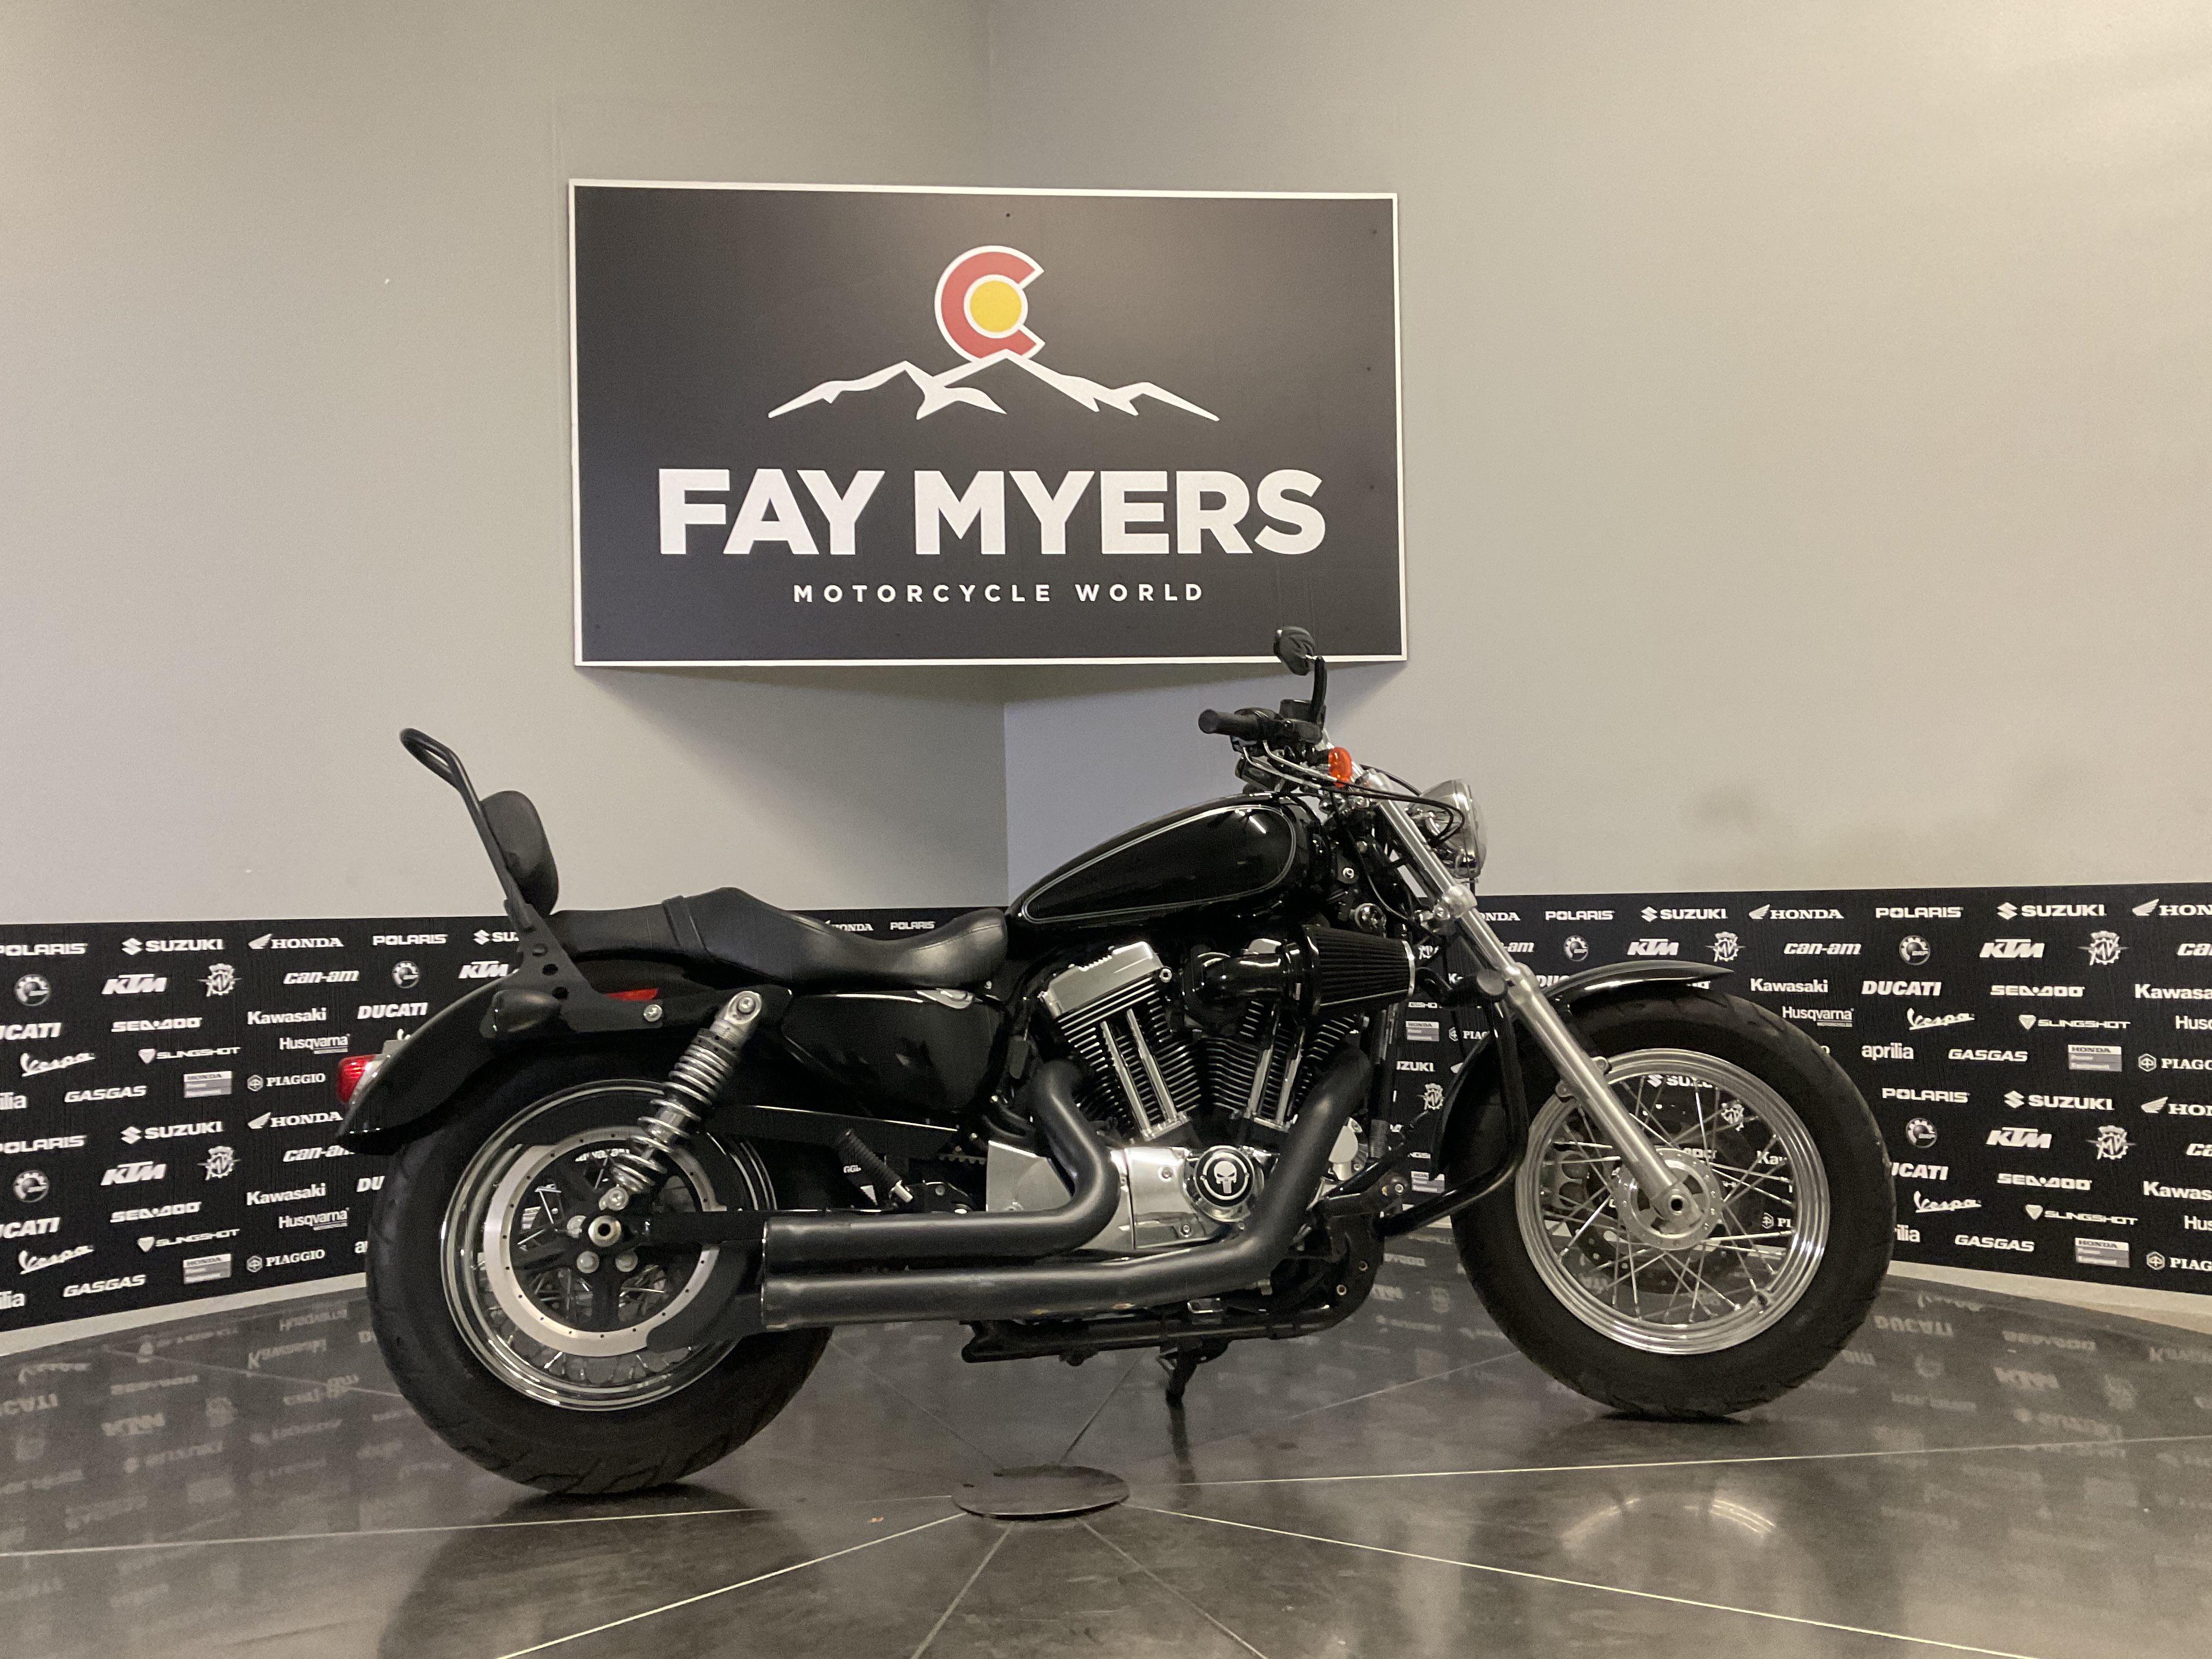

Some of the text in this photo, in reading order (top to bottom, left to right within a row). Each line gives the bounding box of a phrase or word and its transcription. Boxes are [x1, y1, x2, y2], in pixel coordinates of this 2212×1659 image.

[659, 469, 1325, 555] FAY MYERS
[794, 583, 1202, 603] MOTORCYCLE WORLD
[1545, 910, 1613, 920] POLARIS
[1660, 909, 1728, 919] SUZUKI
[1770, 910, 1844, 919] HONDA
[1876, 907, 1963, 918] POLARIS
[2022, 905, 2107, 917] SUZUKI
[2159, 905, 2212, 916] HON
[890, 921, 935, 930] POLARIS
[145, 939, 224, 952] SUZUKI
[271, 938, 343, 949] HONDA
[373, 934, 447, 945] POLARIS
[1627, 939, 1679, 955] KTM
[1784, 944, 1861, 955] can-am
[1979, 939, 2045, 958] KTM
[284, 970, 359, 984] can-am
[459, 961, 509, 979] KTM
[102, 974, 167, 994] KTM
[1751, 978, 1828, 992] Kawasaki
[1861, 981, 1942, 996] DUCATI
[2135, 984, 2212, 999] Kawasa
[247, 1008, 326, 1024] Kawasaki
[358, 1002, 428, 1019] DUCATI
[1782, 1006, 1852, 1021] Husqvarna
[1907, 1008, 1974, 1030] Vespa
[2038, 1019, 2131, 1029] SLINGSHOT
[280, 1036, 348, 1049] Husqvarna
[156, 1047, 240, 1059] SLINGSHOT
[1862, 1042, 1914, 1060] aprilia
[1949, 1049, 2028, 1062] GASGAS
[20, 1053, 95, 1076] Vespa
[267, 1073, 325, 1086] PIAGGIO
[65, 1086, 146, 1102] GASGAS
[1882, 1088, 1968, 1103] POLARIS
[2029, 1095, 2114, 1110] SUZUKI
[270, 1111, 343, 1127] HONDA
[145, 1121, 223, 1139] SUZUKI
[1986, 1127, 2052, 1148] KTM
[101, 1161, 167, 1186] KTM
[247, 1183, 326, 1205] Kawasaki
[2143, 1181, 2212, 1200] Kawas
[1914, 1191, 1981, 1212] Vespa
[279, 1210, 347, 1228] Husqvarna
[2045, 1211, 2138, 1225] SLINGSHOT
[156, 1229, 240, 1246] SLINGSHOT
[1955, 1235, 2034, 1251] GASGAS
[19, 1246, 94, 1274] Vespa
[266, 1249, 325, 1266] PIAGGIO
[63, 1274, 145, 1297] GASGAS
